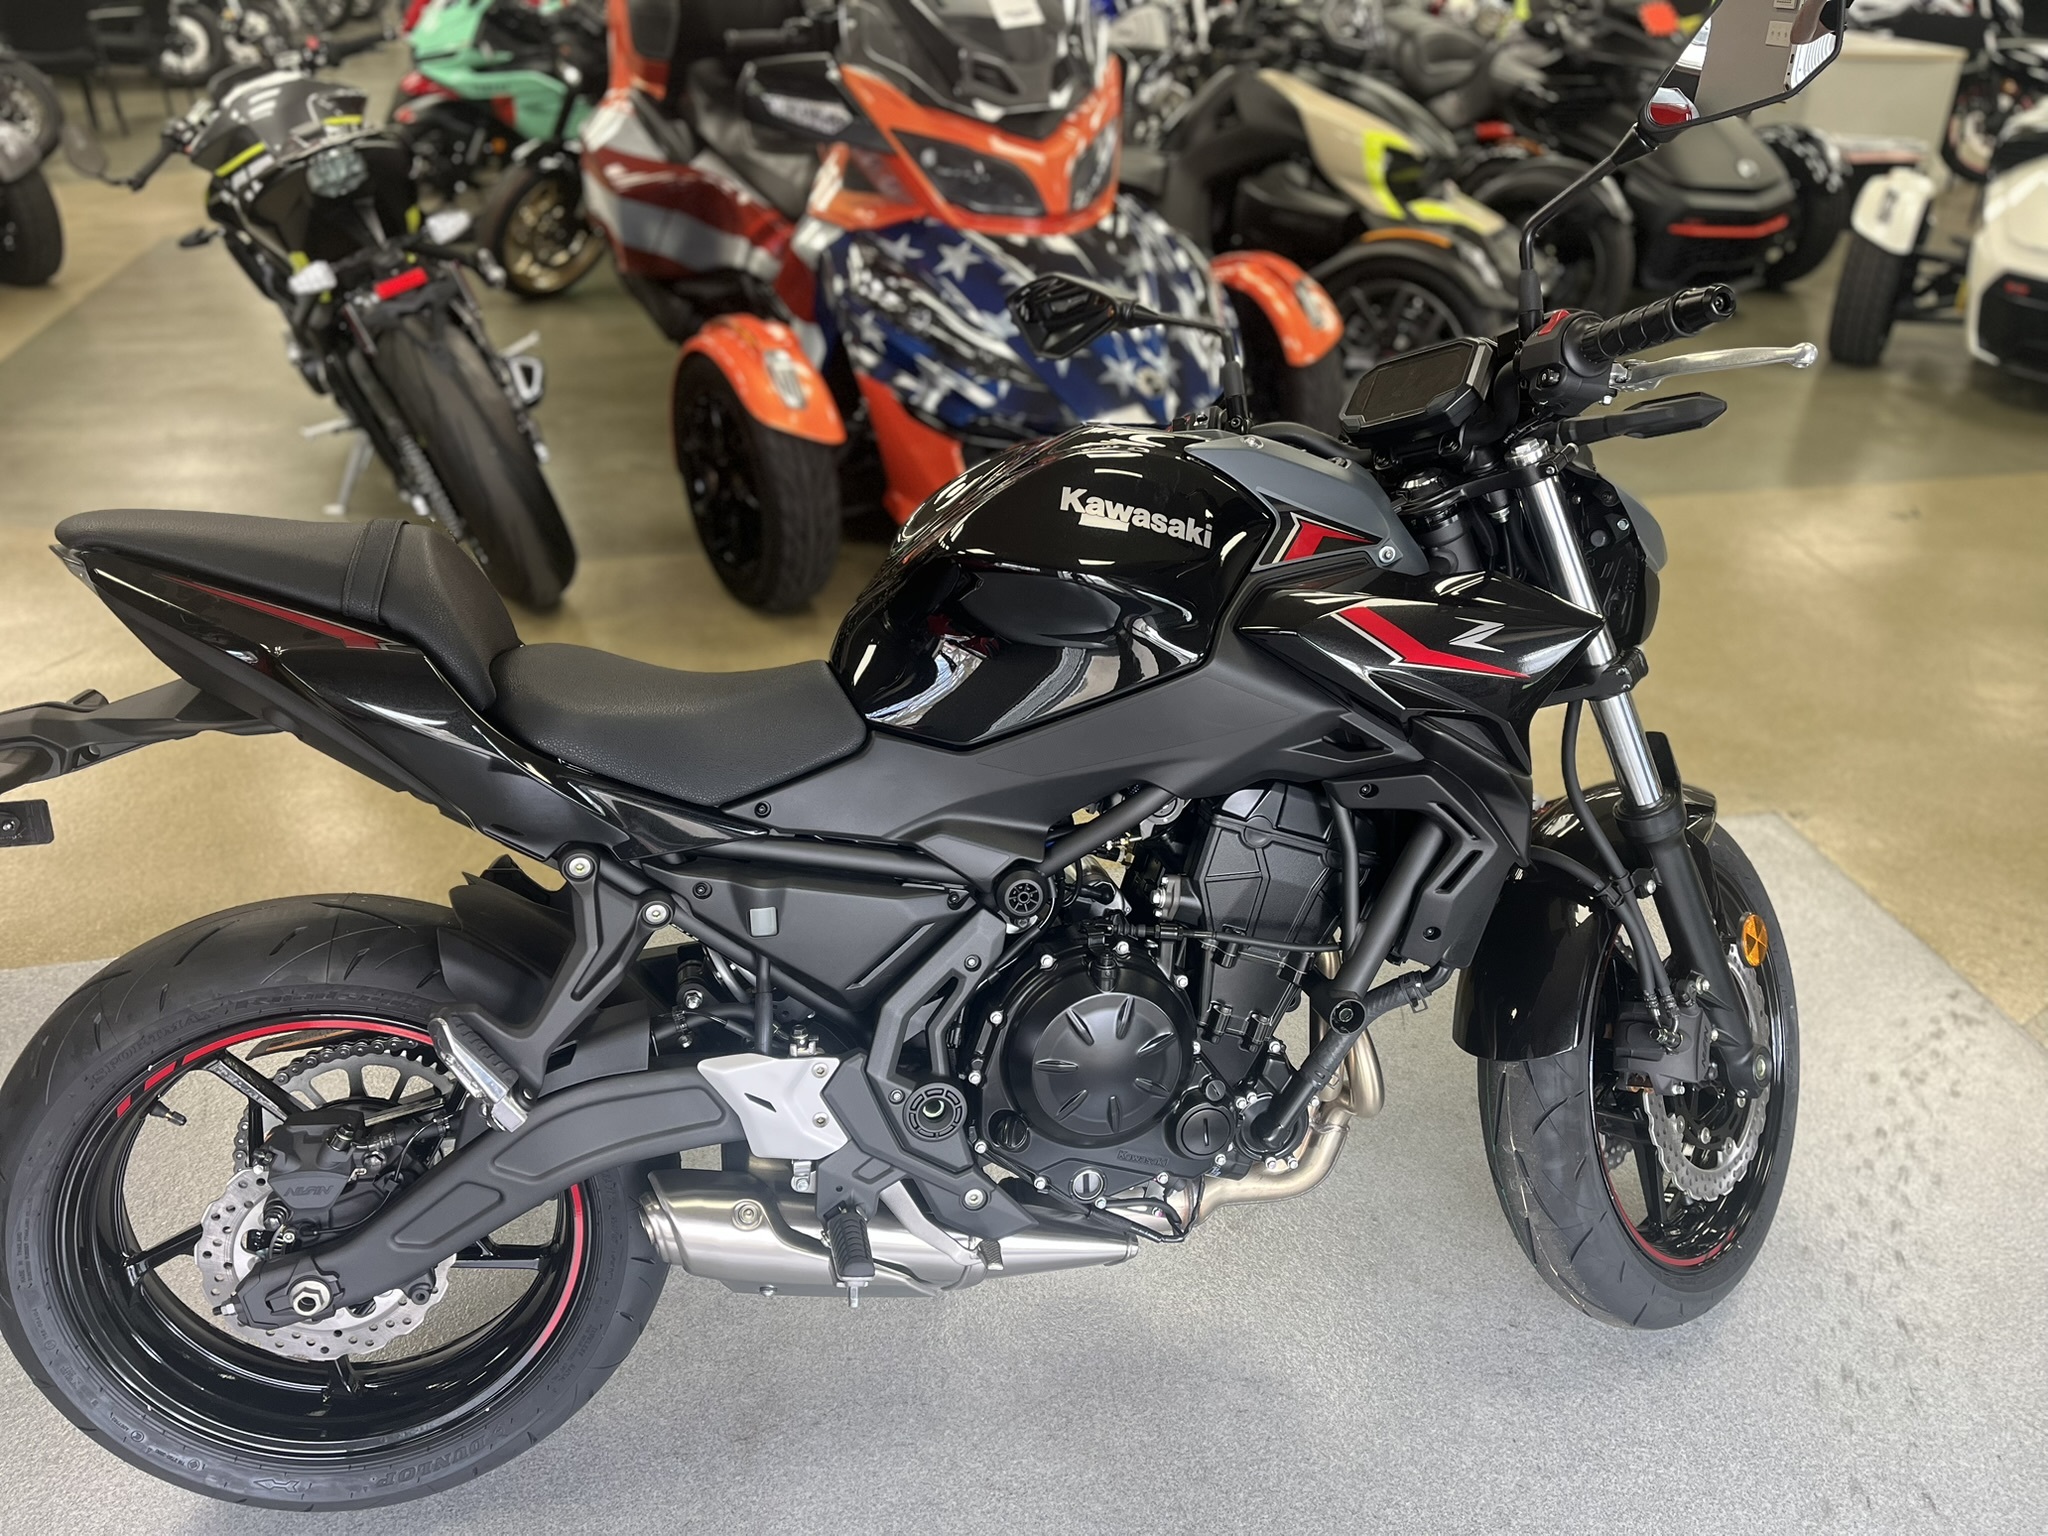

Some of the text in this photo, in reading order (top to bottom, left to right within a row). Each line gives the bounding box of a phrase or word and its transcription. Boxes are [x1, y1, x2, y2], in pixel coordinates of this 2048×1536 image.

[1060, 486, 1213, 549] Kawasaki
[1448, 616, 1506, 653] Z
[1117, 1150, 1169, 1168] Kawasaki
[375, 1434, 487, 1488] DUNLOP
